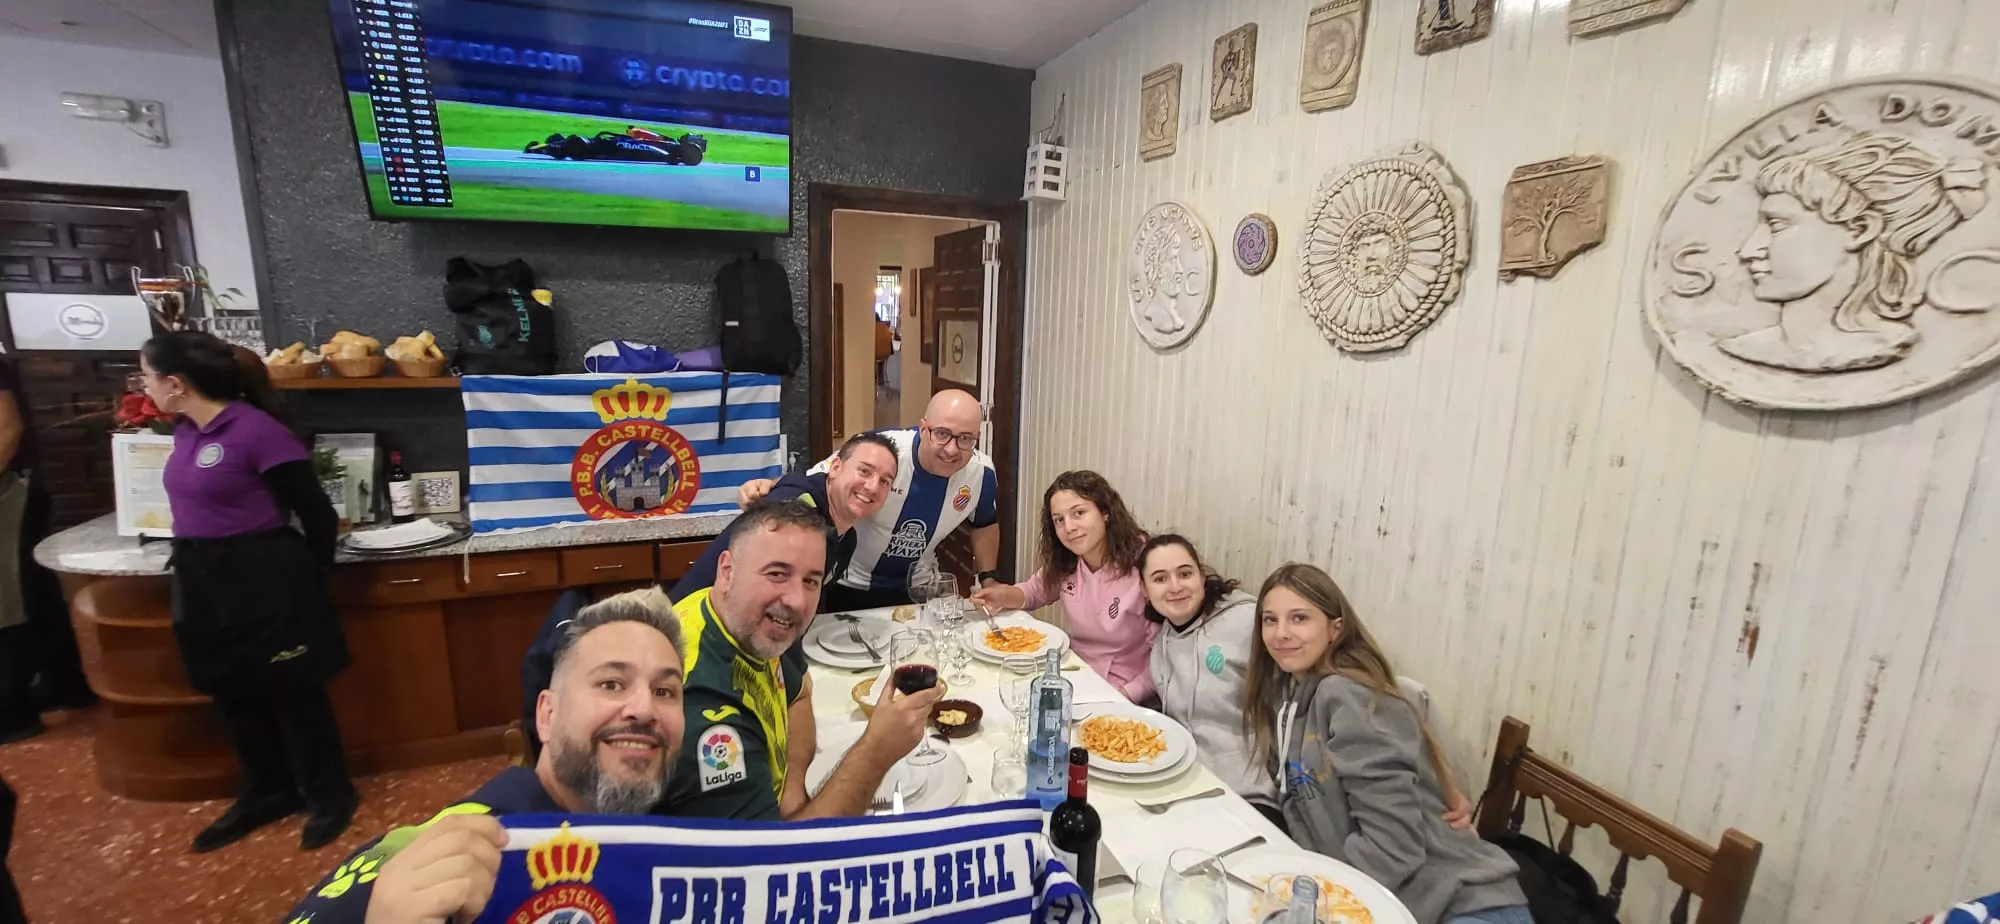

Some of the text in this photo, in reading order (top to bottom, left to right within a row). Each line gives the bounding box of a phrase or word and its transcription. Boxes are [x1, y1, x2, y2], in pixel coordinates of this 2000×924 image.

[1671, 244, 1715, 298] S
[597, 425, 696, 490] CASTELLBELL
[887, 545, 925, 557] MAYA
[890, 537, 926, 549] RIVIERA
[706, 771, 742, 785] LaLiga
[766, 843, 1015, 924] CASTELLBELL
